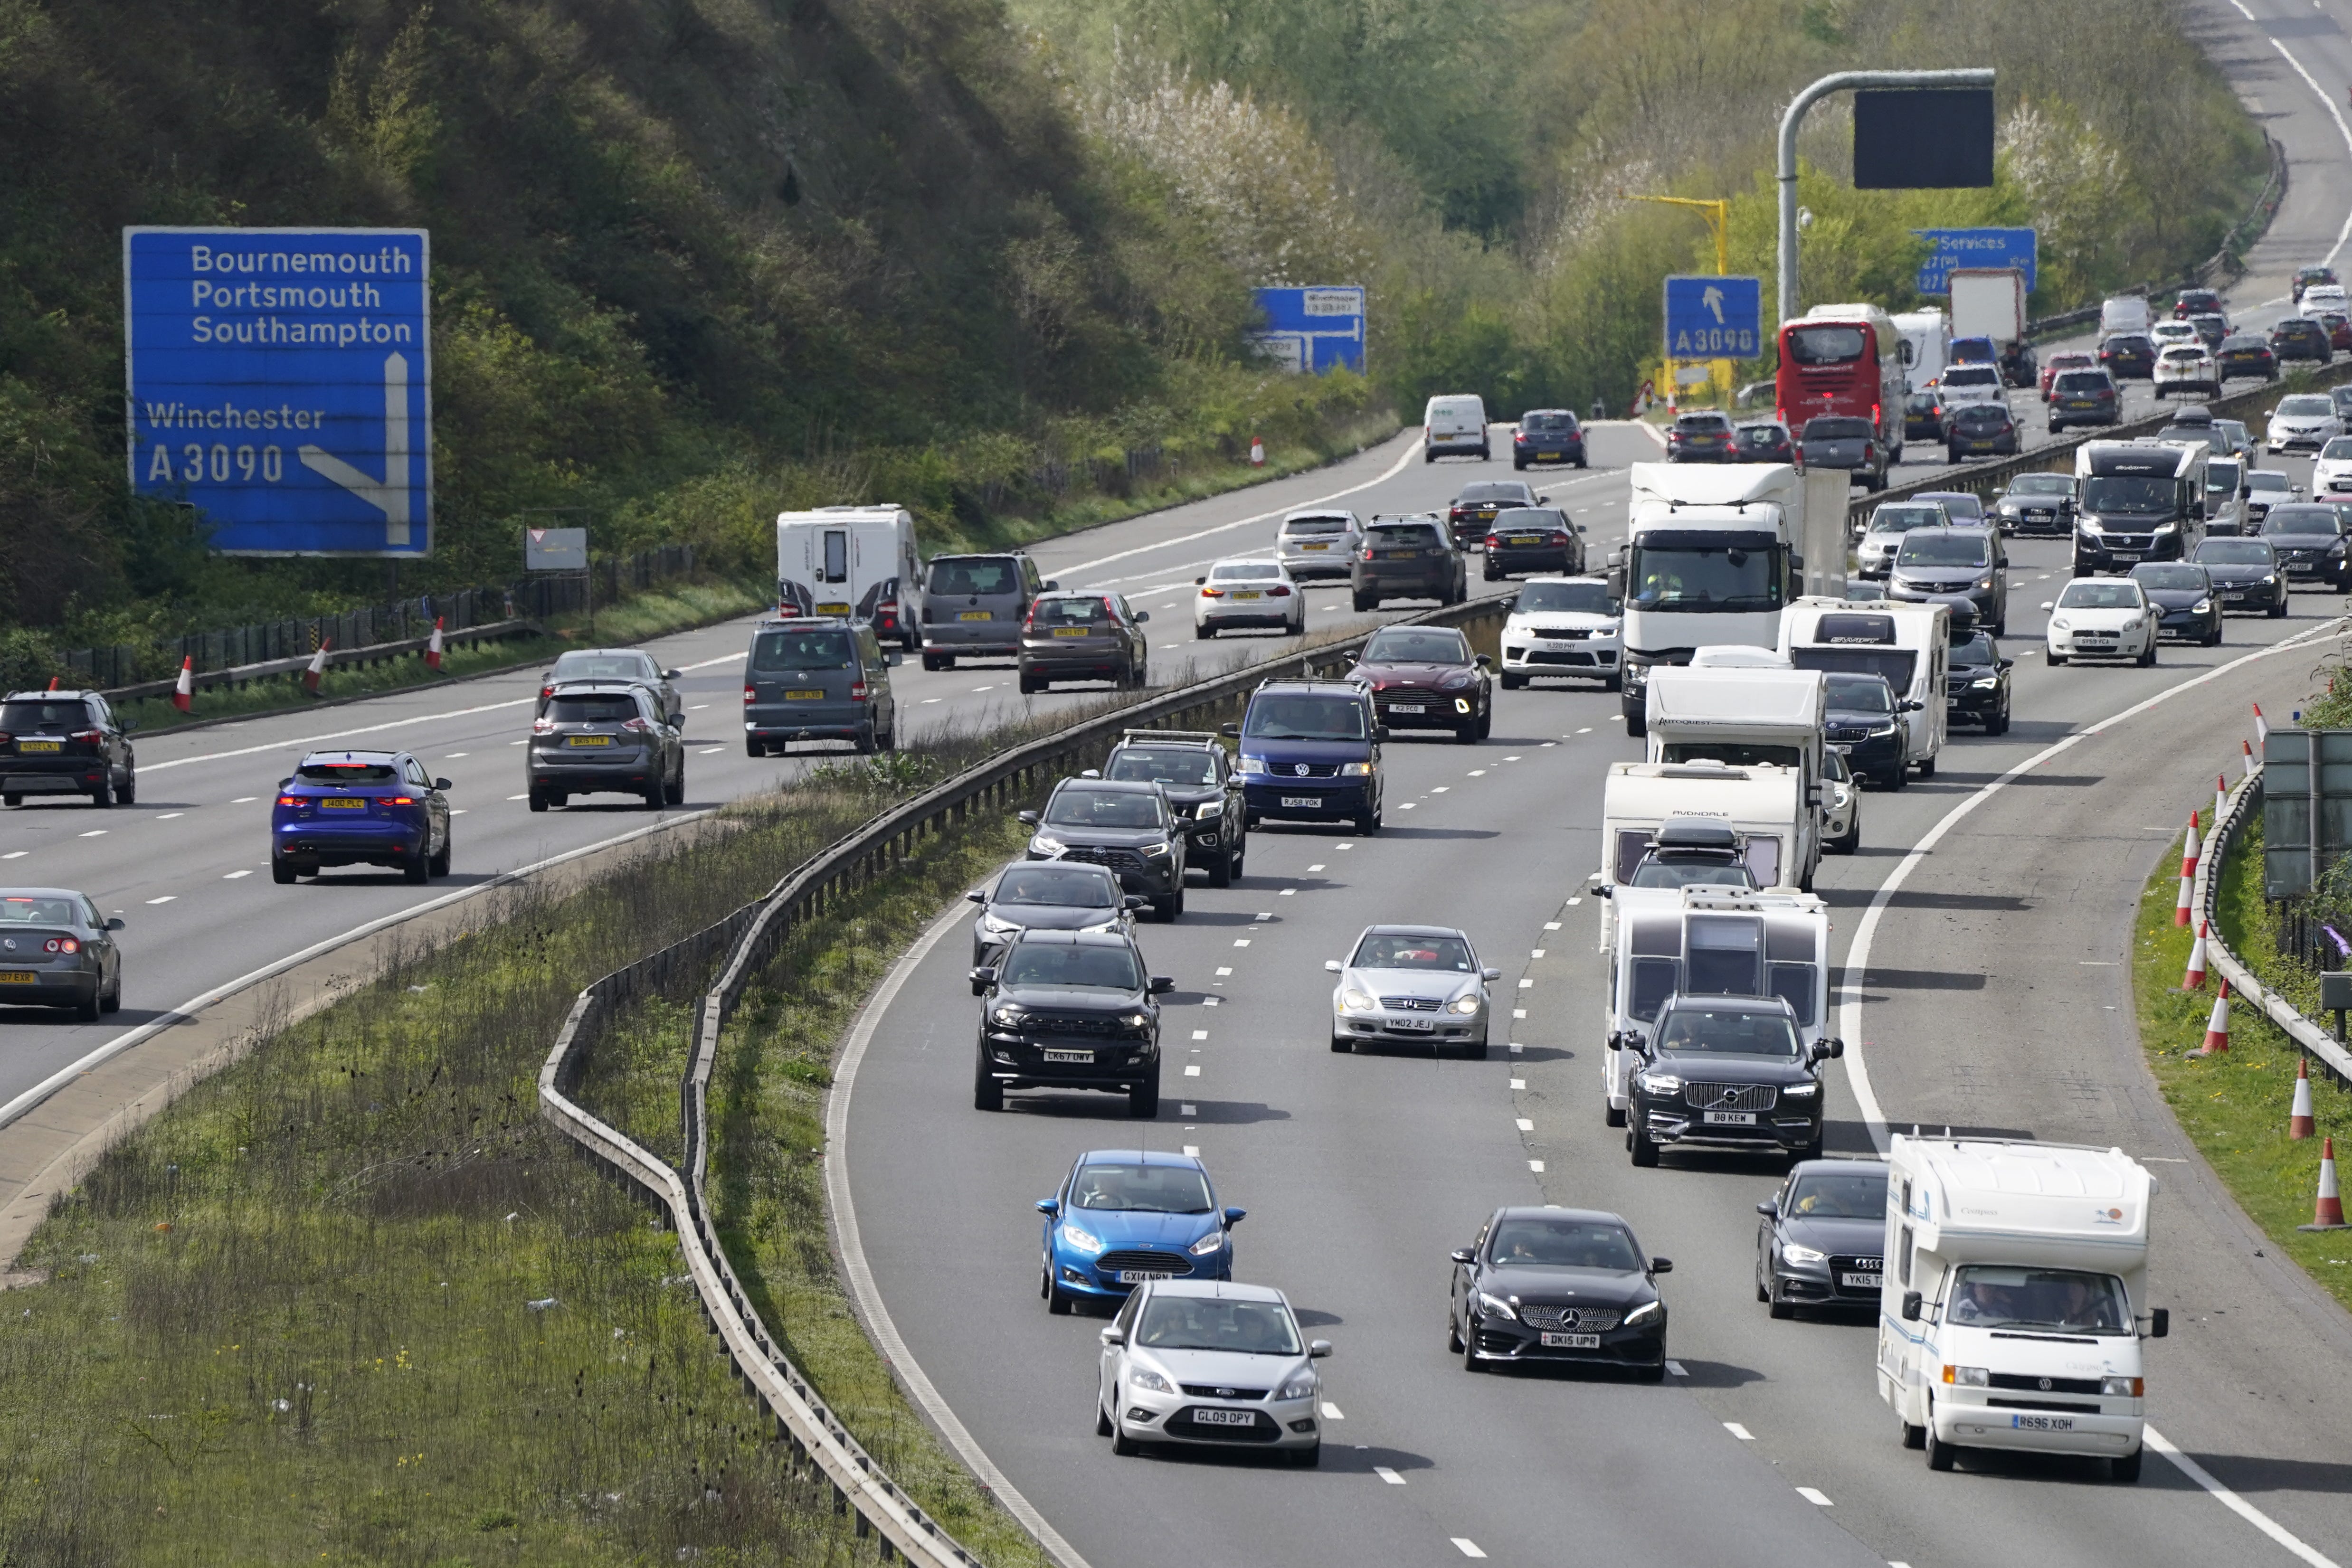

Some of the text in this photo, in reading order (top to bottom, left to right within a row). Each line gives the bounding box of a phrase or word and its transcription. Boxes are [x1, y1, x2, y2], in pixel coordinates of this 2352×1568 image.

[1940, 236, 2006, 251] Services
[192, 245, 410, 274] Bournemouth
[192, 280, 380, 308] Portsmouth
[192, 316, 411, 348] Southampton
[1676, 328, 1753, 352] A3090
[145, 402, 326, 429] Winchester
[14, 973, 31, 982] EXR
[1390, 1019, 1430, 1029] YM02 JEJ
[1714, 1113, 1746, 1122] B8 KEN
[1961, 1207, 1998, 1217] Compass
[1124, 1272, 1146, 1283] GX14
[1849, 1275, 1871, 1285] YK15
[1551, 1335, 1597, 1345] DK15 UPR
[1198, 1411, 1252, 1424] GL09 OPY
[2020, 1417, 2073, 1429] R696 XOH
